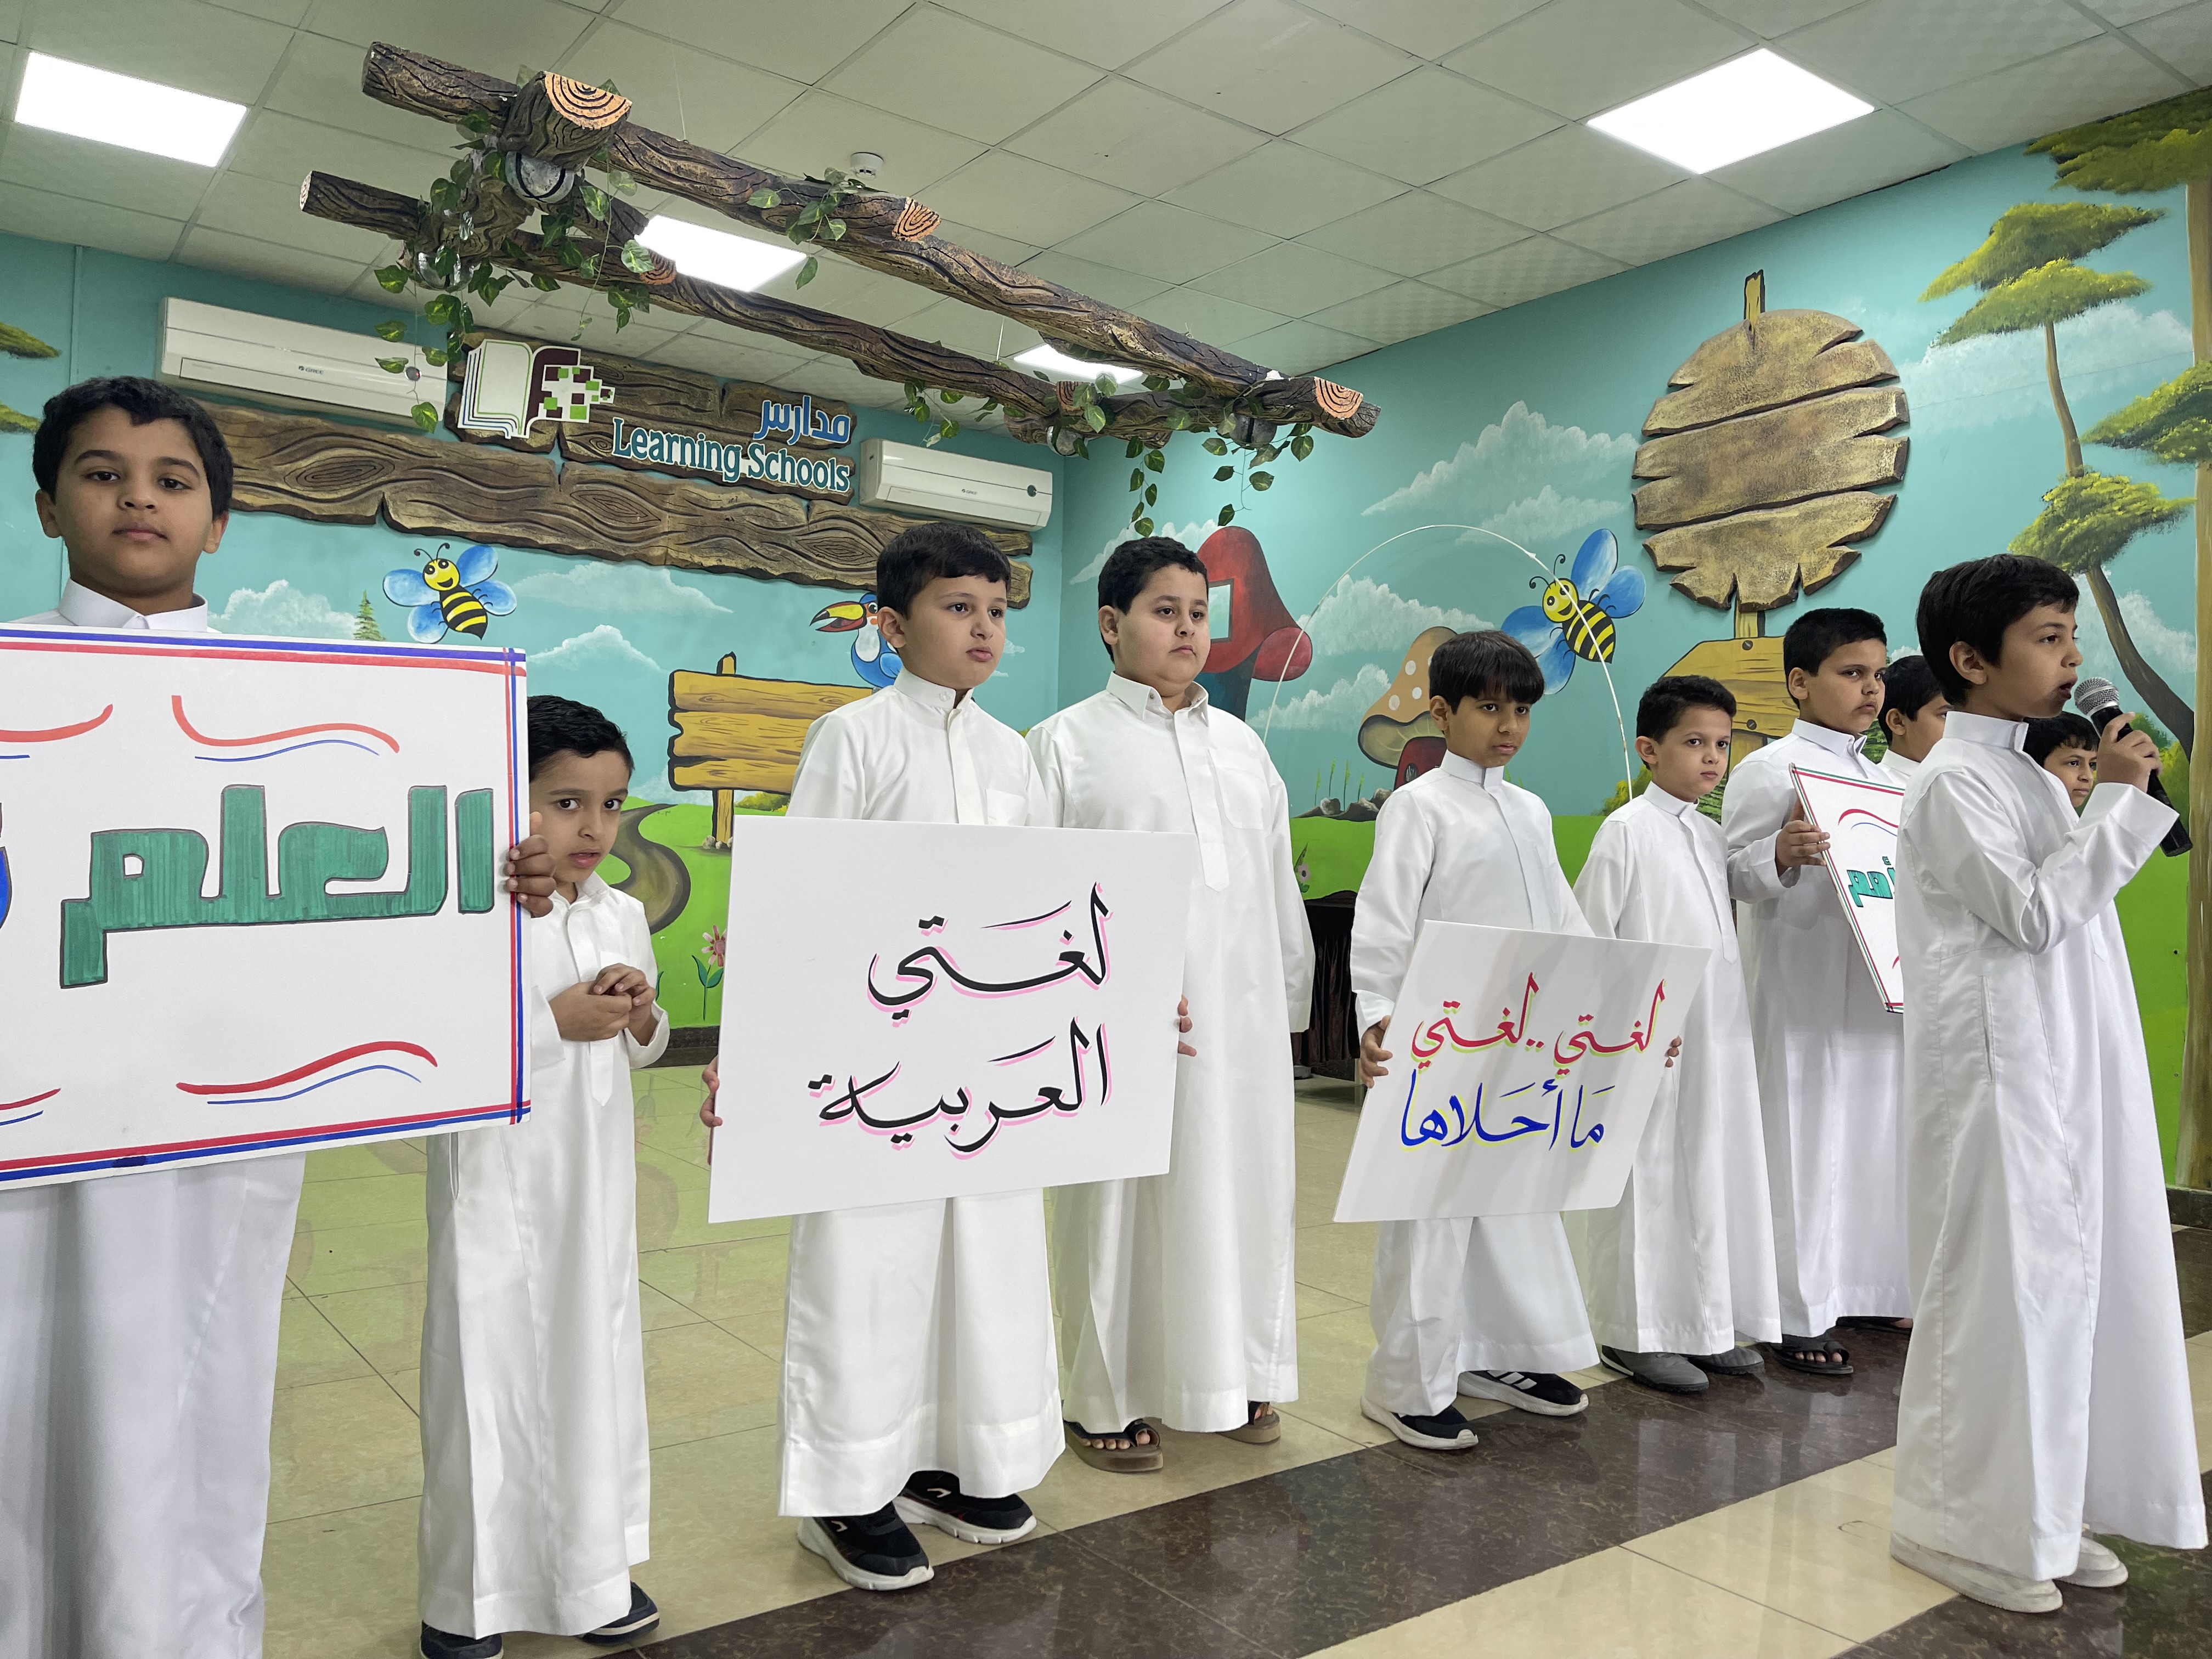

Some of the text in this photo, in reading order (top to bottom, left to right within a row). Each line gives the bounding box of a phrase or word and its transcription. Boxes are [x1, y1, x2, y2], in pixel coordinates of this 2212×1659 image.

[612, 417, 850, 493] Learning Schools
[753, 394, 850, 444] مدارس
[59, 784, 495, 990] العلم
